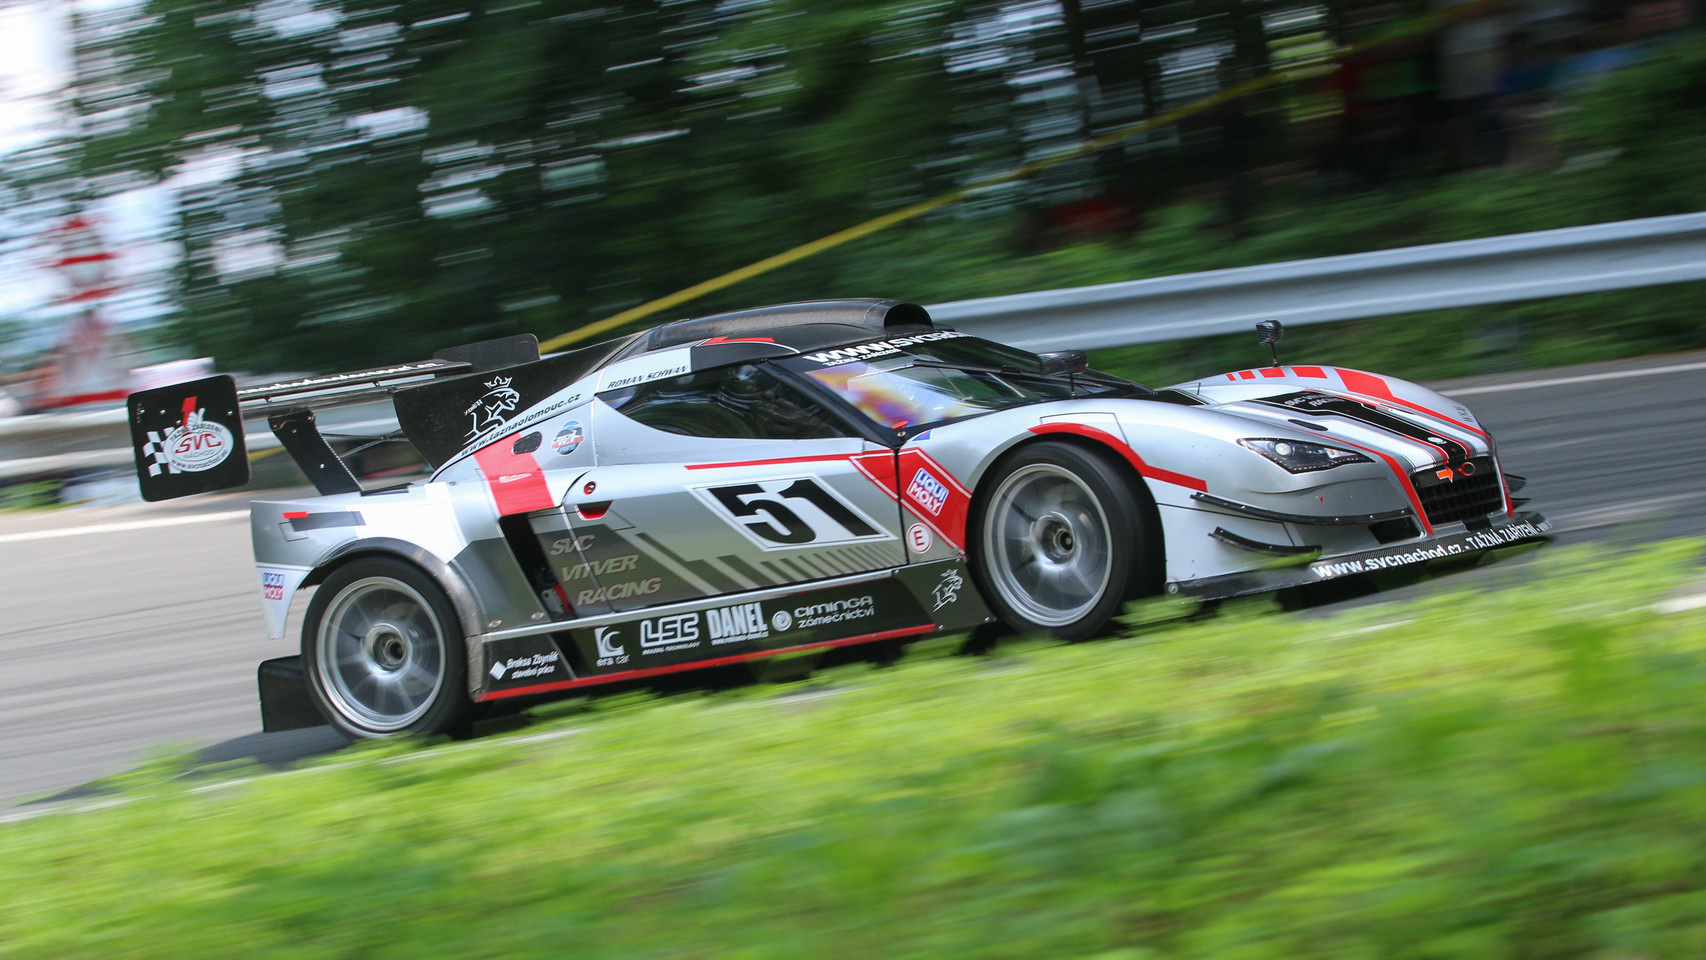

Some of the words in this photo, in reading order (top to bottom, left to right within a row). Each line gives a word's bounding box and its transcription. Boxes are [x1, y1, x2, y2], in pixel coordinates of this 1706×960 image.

[607, 375, 646, 389] ROMAN
[646, 364, 688, 381] SCHWAN
[460, 393, 581, 457] www.taznaolomouc.cz
[174, 432, 222, 454] SVC
[910, 482, 942, 512] MOLY
[915, 470, 947, 502] LIQUI
[707, 479, 880, 544] 51
[550, 535, 595, 556] SVC
[914, 530, 925, 546] E
[562, 555, 639, 581] VITVER
[1312, 543, 1462, 578] www.svcnachod.cz
[1465, 532, 1505, 550] TAŽNÁ
[577, 577, 661, 606] RACING
[706, 602, 768, 640] DANEL
